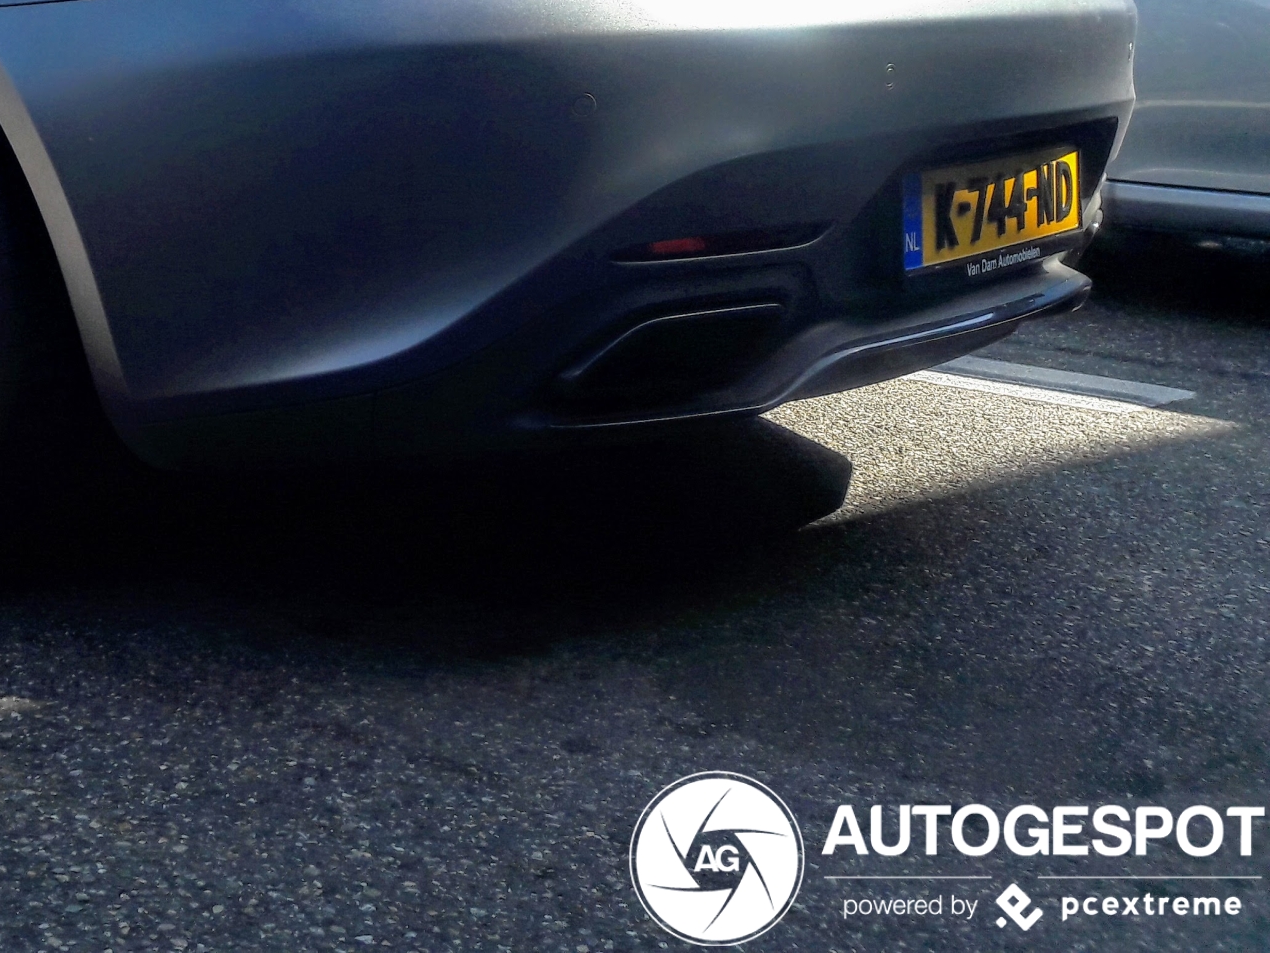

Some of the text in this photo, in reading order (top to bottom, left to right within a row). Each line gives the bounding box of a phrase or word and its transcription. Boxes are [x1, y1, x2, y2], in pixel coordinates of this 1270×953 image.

[933, 160, 1073, 252] K-744-ND
[905, 232, 920, 252] NL
[966, 246, 1041, 277] Van Dam Automobielen
